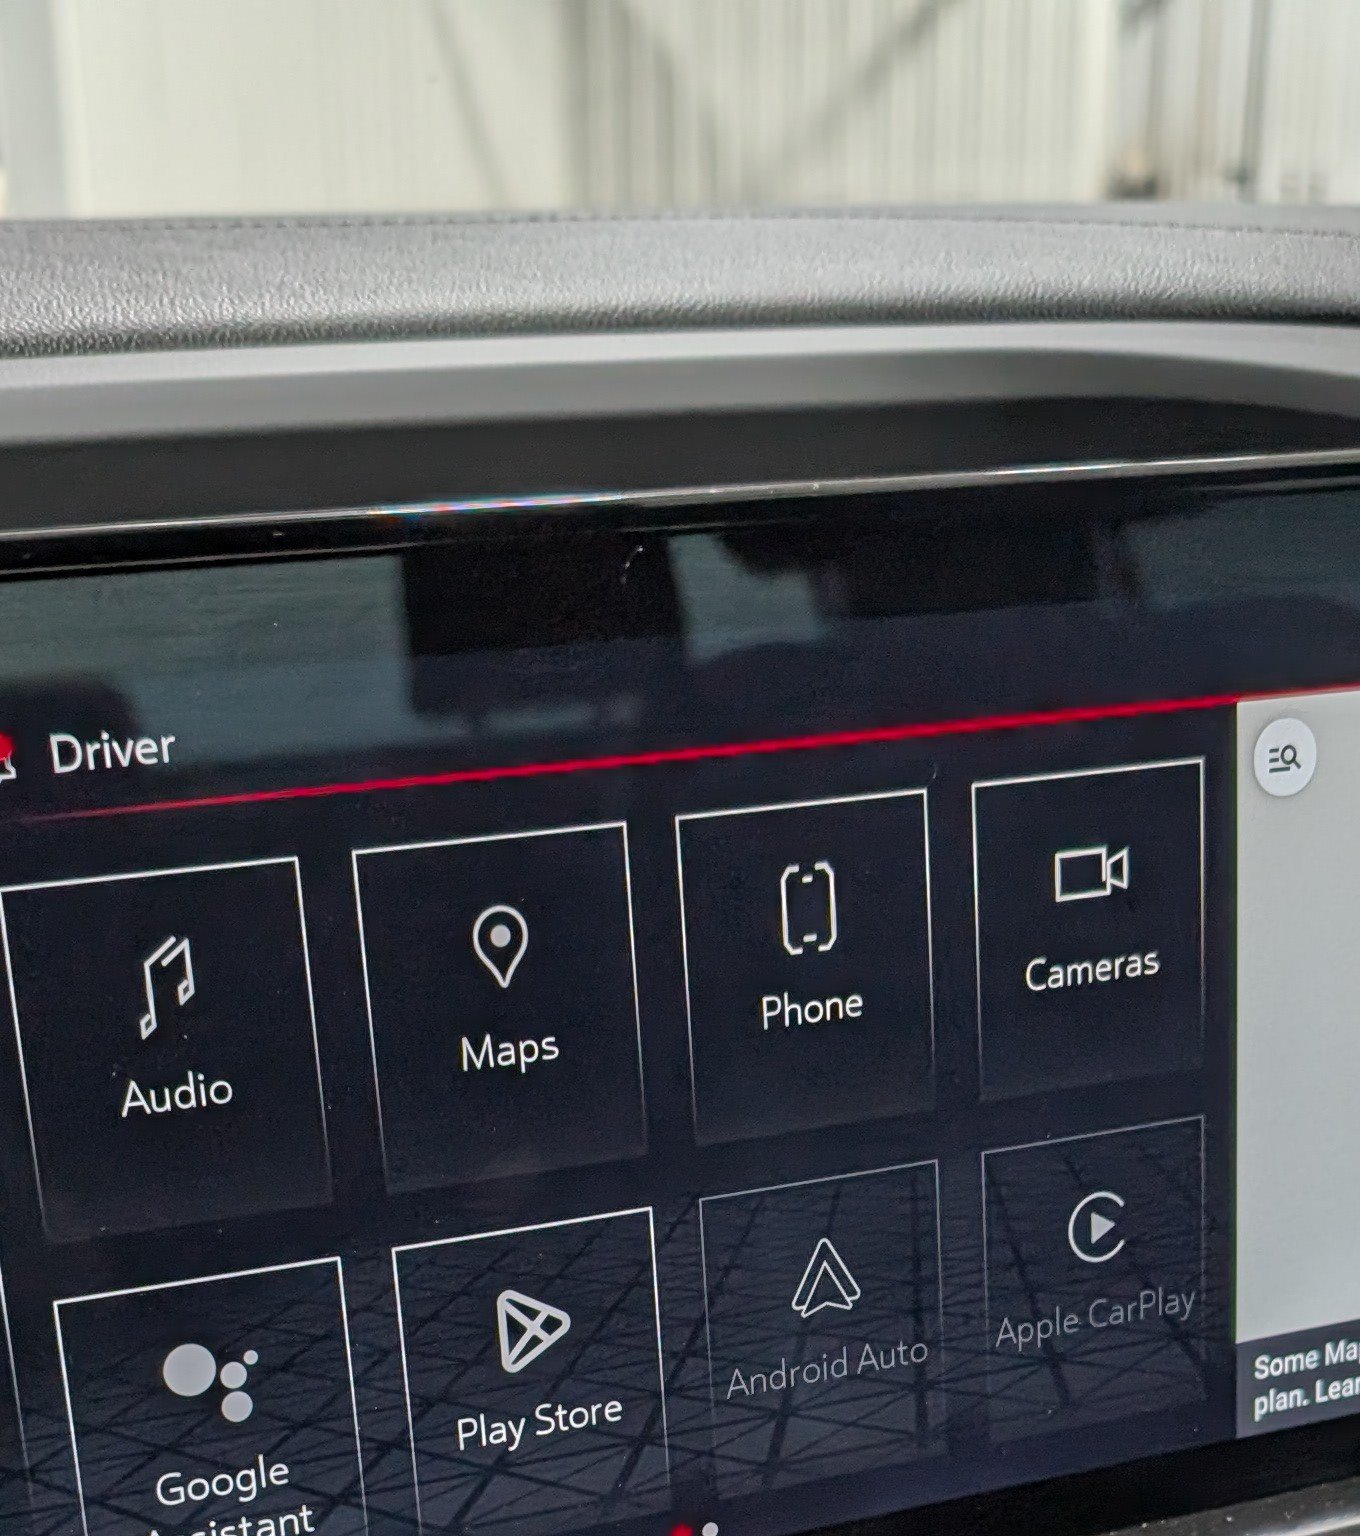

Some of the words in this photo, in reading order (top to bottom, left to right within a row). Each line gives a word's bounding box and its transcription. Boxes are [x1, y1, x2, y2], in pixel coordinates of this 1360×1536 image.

[49, 731, 176, 774] Driver
[1025, 948, 1160, 992] Cameras
[761, 990, 863, 1031] Phone
[459, 1032, 560, 1074] Maps
[120, 1070, 234, 1117] Audio
[995, 1305, 1079, 1352] Apple
[1088, 1286, 1196, 1329] CarPlay
[726, 1347, 849, 1400] Android
[856, 1340, 929, 1377] Auto
[1253, 1349, 1318, 1381] Some
[1253, 1382, 1309, 1422] plan.
[456, 1413, 526, 1452] Play
[535, 1400, 623, 1437] Store
[155, 1455, 290, 1506] Google
